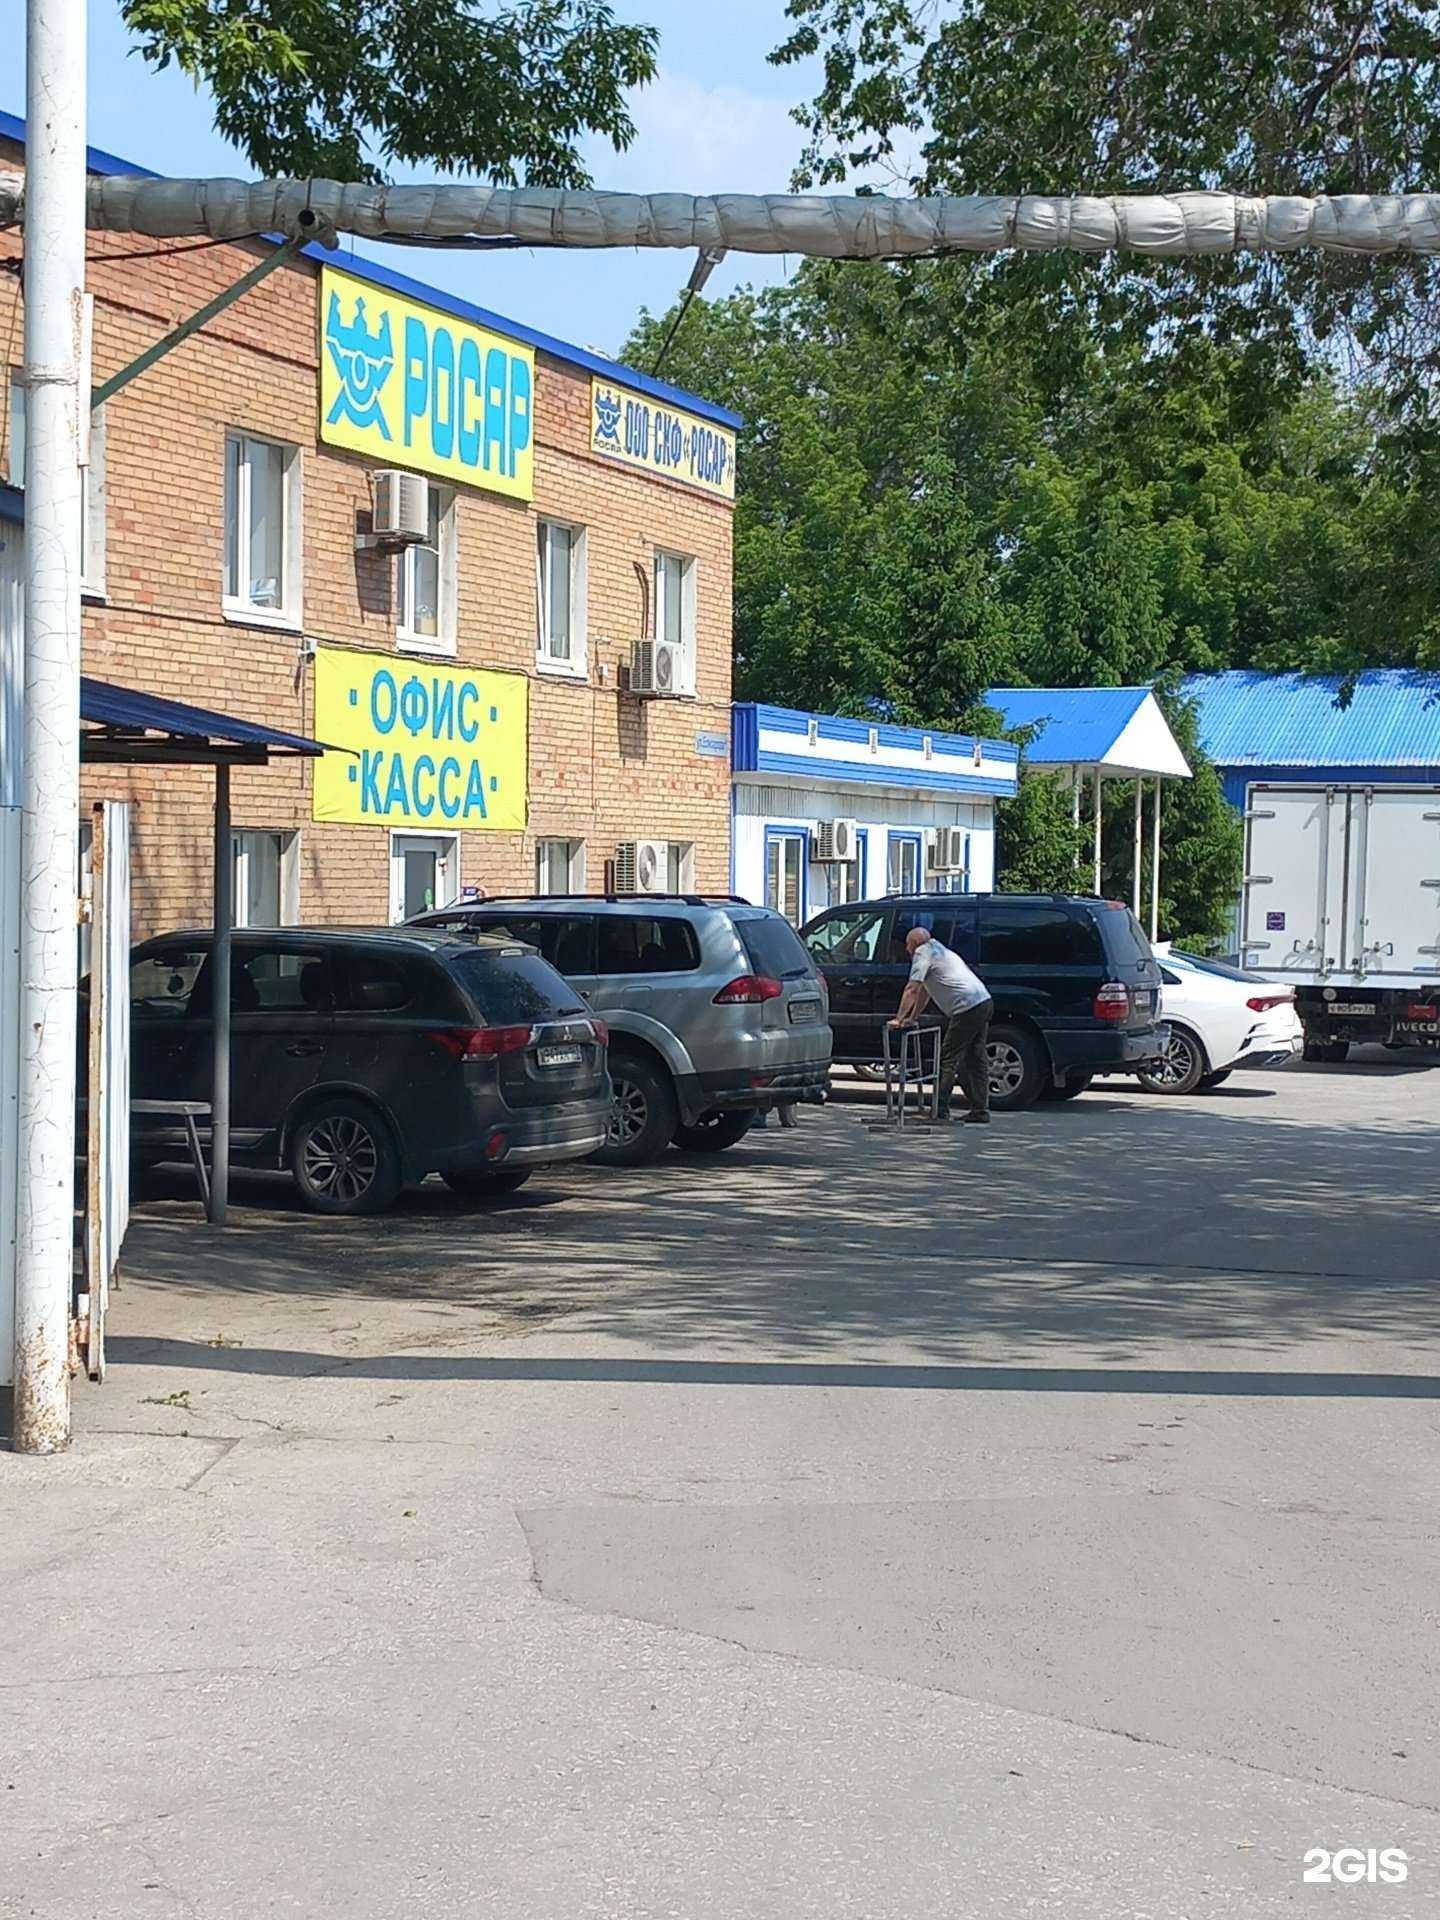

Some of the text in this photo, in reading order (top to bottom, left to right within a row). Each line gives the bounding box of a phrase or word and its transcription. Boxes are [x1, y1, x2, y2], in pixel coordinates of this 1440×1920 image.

[404, 316, 530, 478] РОСАР
[654, 410, 682, 468] СКФ
[371, 669, 480, 743] ОФИС
[361, 749, 488, 819] КАССА
[1396, 1021, 1438, 1032] IVECO
